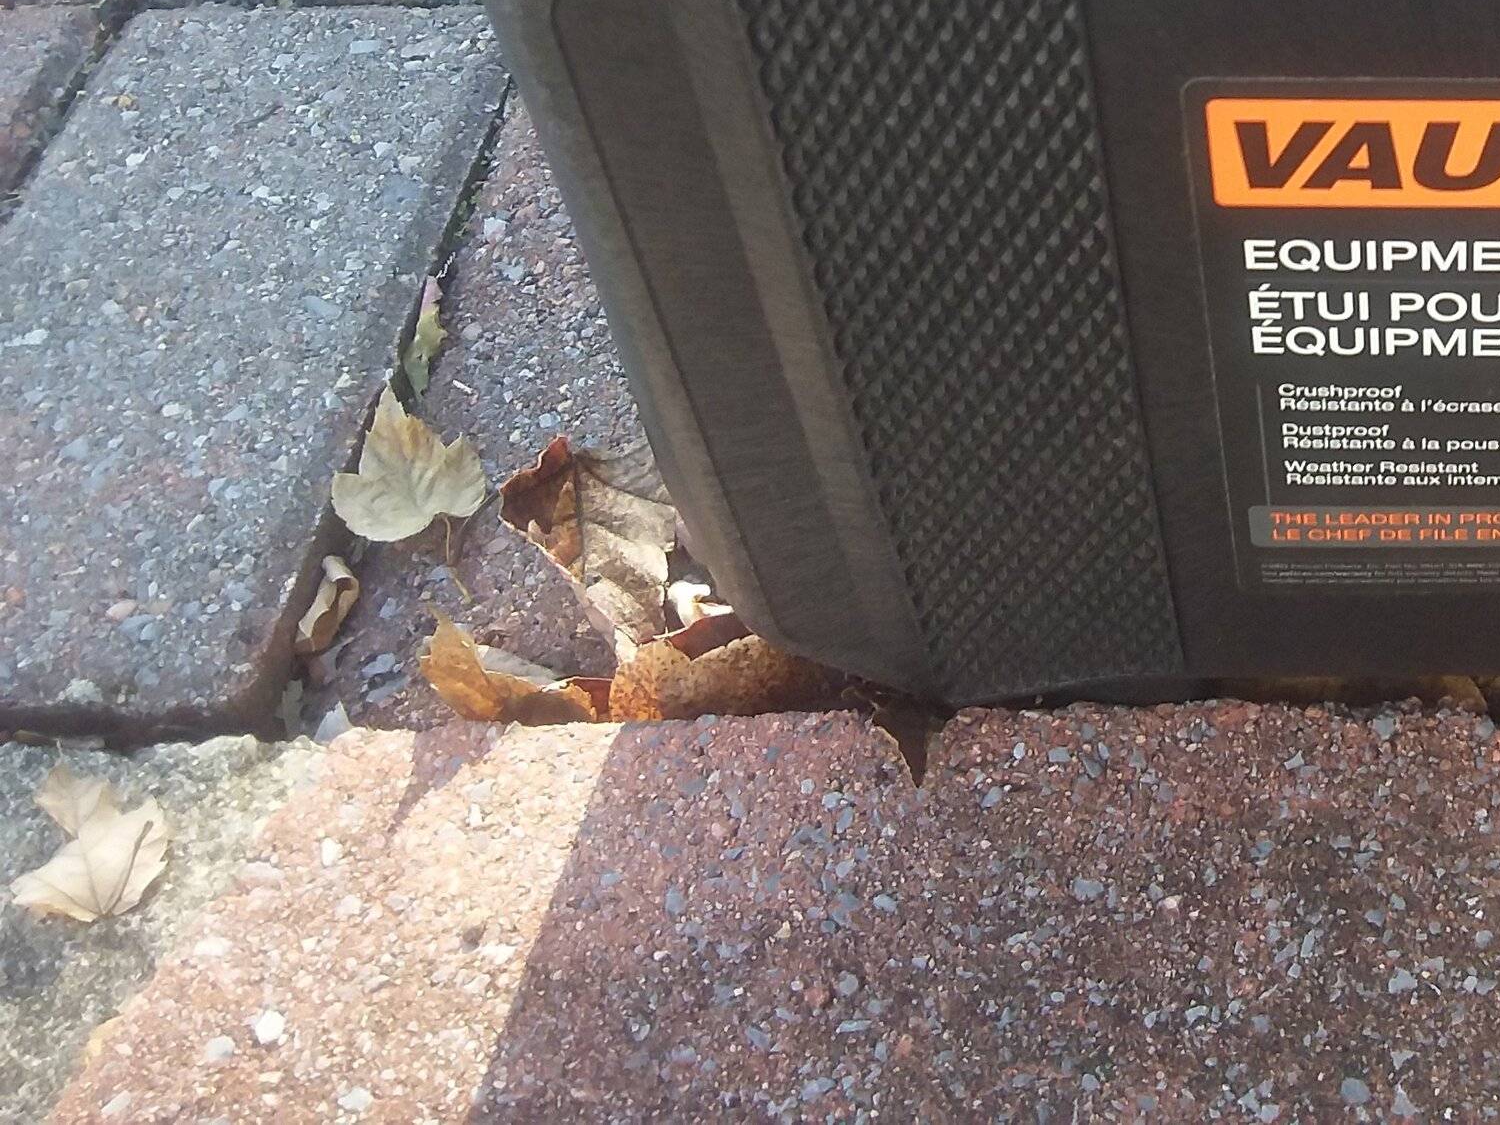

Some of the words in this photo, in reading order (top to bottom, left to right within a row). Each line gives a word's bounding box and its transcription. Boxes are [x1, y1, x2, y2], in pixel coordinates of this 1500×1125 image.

[1248, 284, 1370, 322] ÉTUI
[1278, 383, 1403, 399] Crushproof
[1279, 396, 1395, 412] Résistante
[1401, 398, 1415, 413] à
[1281, 422, 1390, 437] Dustproof
[1282, 435, 1396, 450] Résistante
[1402, 437, 1415, 450] à
[1422, 437, 1440, 450] la
[1284, 460, 1374, 474] Weather
[1379, 461, 1479, 474] Resistant
[1286, 473, 1397, 486] Résistante
[1402, 475, 1441, 486] aux
[1270, 513, 1317, 525] THE
[1325, 513, 1420, 525] LEADER
[1428, 513, 1451, 525] IN
[1272, 529, 1300, 541] LE
[1308, 528, 1371, 541] CHEF
[1380, 528, 1411, 540] DE
[1419, 528, 1469, 540] FILE
